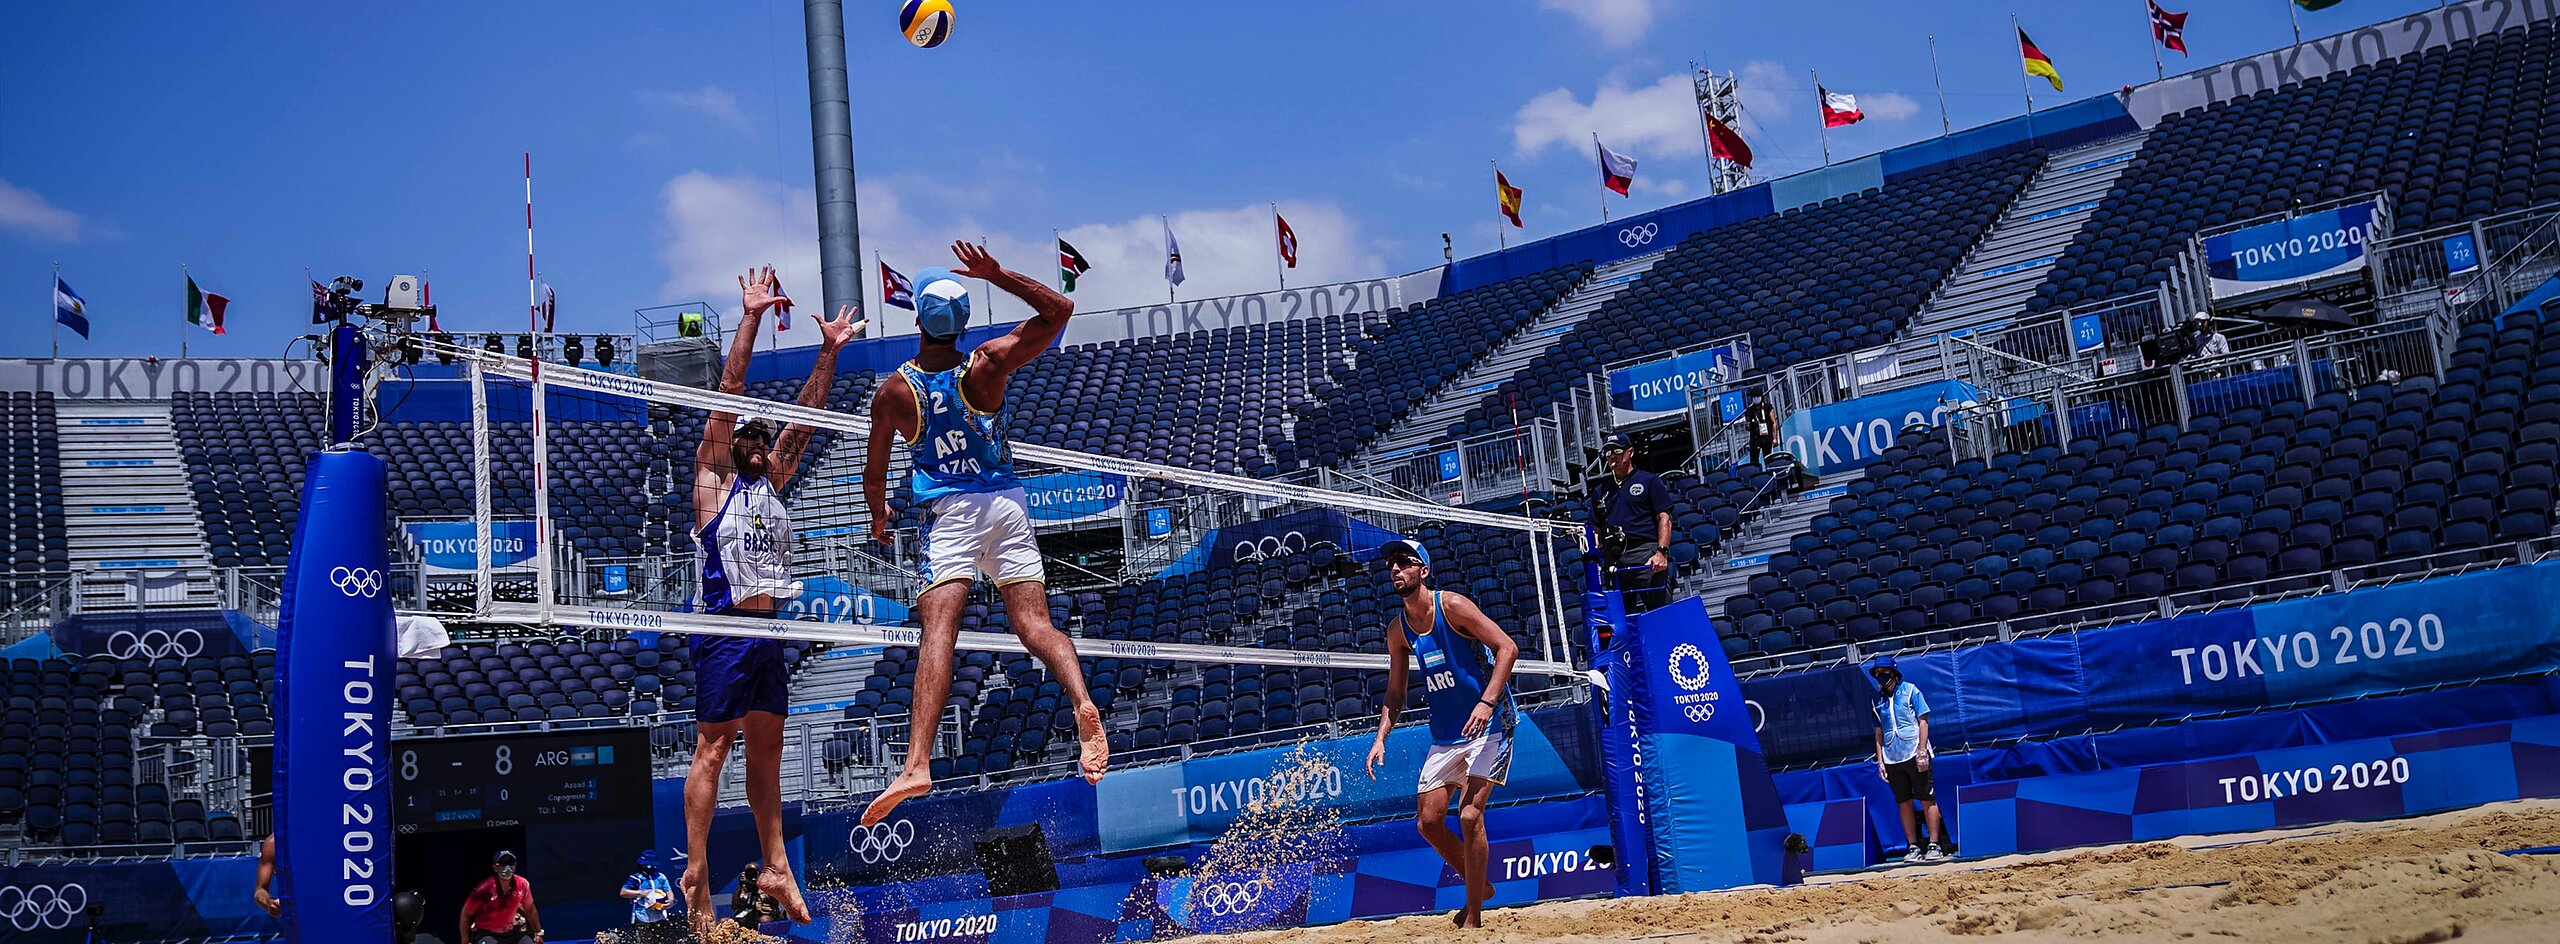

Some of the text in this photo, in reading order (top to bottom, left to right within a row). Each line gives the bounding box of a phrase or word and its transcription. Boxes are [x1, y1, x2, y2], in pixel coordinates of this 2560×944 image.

[2192, 28, 2389, 101] TOKYO
[2231, 226, 2362, 269] TOKYO 2020
[2453, 248, 2470, 260] 212
[1117, 281, 1390, 340] TOKYO 2020
[2080, 328, 2095, 338] 211
[26, 359, 200, 400] TOKYO
[582, 373, 653, 396] TOKYO 2020
[1629, 374, 1684, 400] TOKYO
[930, 391, 947, 415] 2
[1725, 403, 1738, 413] 211
[934, 430, 967, 459] ARG
[1784, 418, 1894, 468] OKYO
[1090, 457, 1116, 470] TOKYO
[1444, 462, 1456, 471] 210
[743, 490, 749, 508] 1
[1076, 484, 1116, 502] 2020
[421, 538, 523, 554] TOKYO 020
[588, 610, 662, 628] TOKYO 2020
[788, 595, 874, 624] 2020
[882, 629, 914, 643] TOKYO
[1111, 643, 1156, 656] TOKYO 2020
[1294, 652, 1331, 665] TOKYO 2020
[2172, 613, 2446, 685] TOKYO 2020
[1426, 670, 1456, 693] ARG
[1673, 691, 1719, 705] TOKYO 2020
[401, 750, 418, 781] 8
[495, 744, 513, 775] 8
[535, 751, 569, 767] ARG
[1627, 699, 1646, 825] TOKYO 2020
[343, 654, 374, 907] TOKYO 2020
[1171, 766, 1342, 817] TOKYO 2020
[2218, 757, 2410, 804] TOKYO 2020
[407, 796, 414, 807] 1
[500, 789, 508, 801] 0
[1502, 850, 1578, 880] TOKYO
[895, 914, 998, 943] TOKYO 2020
